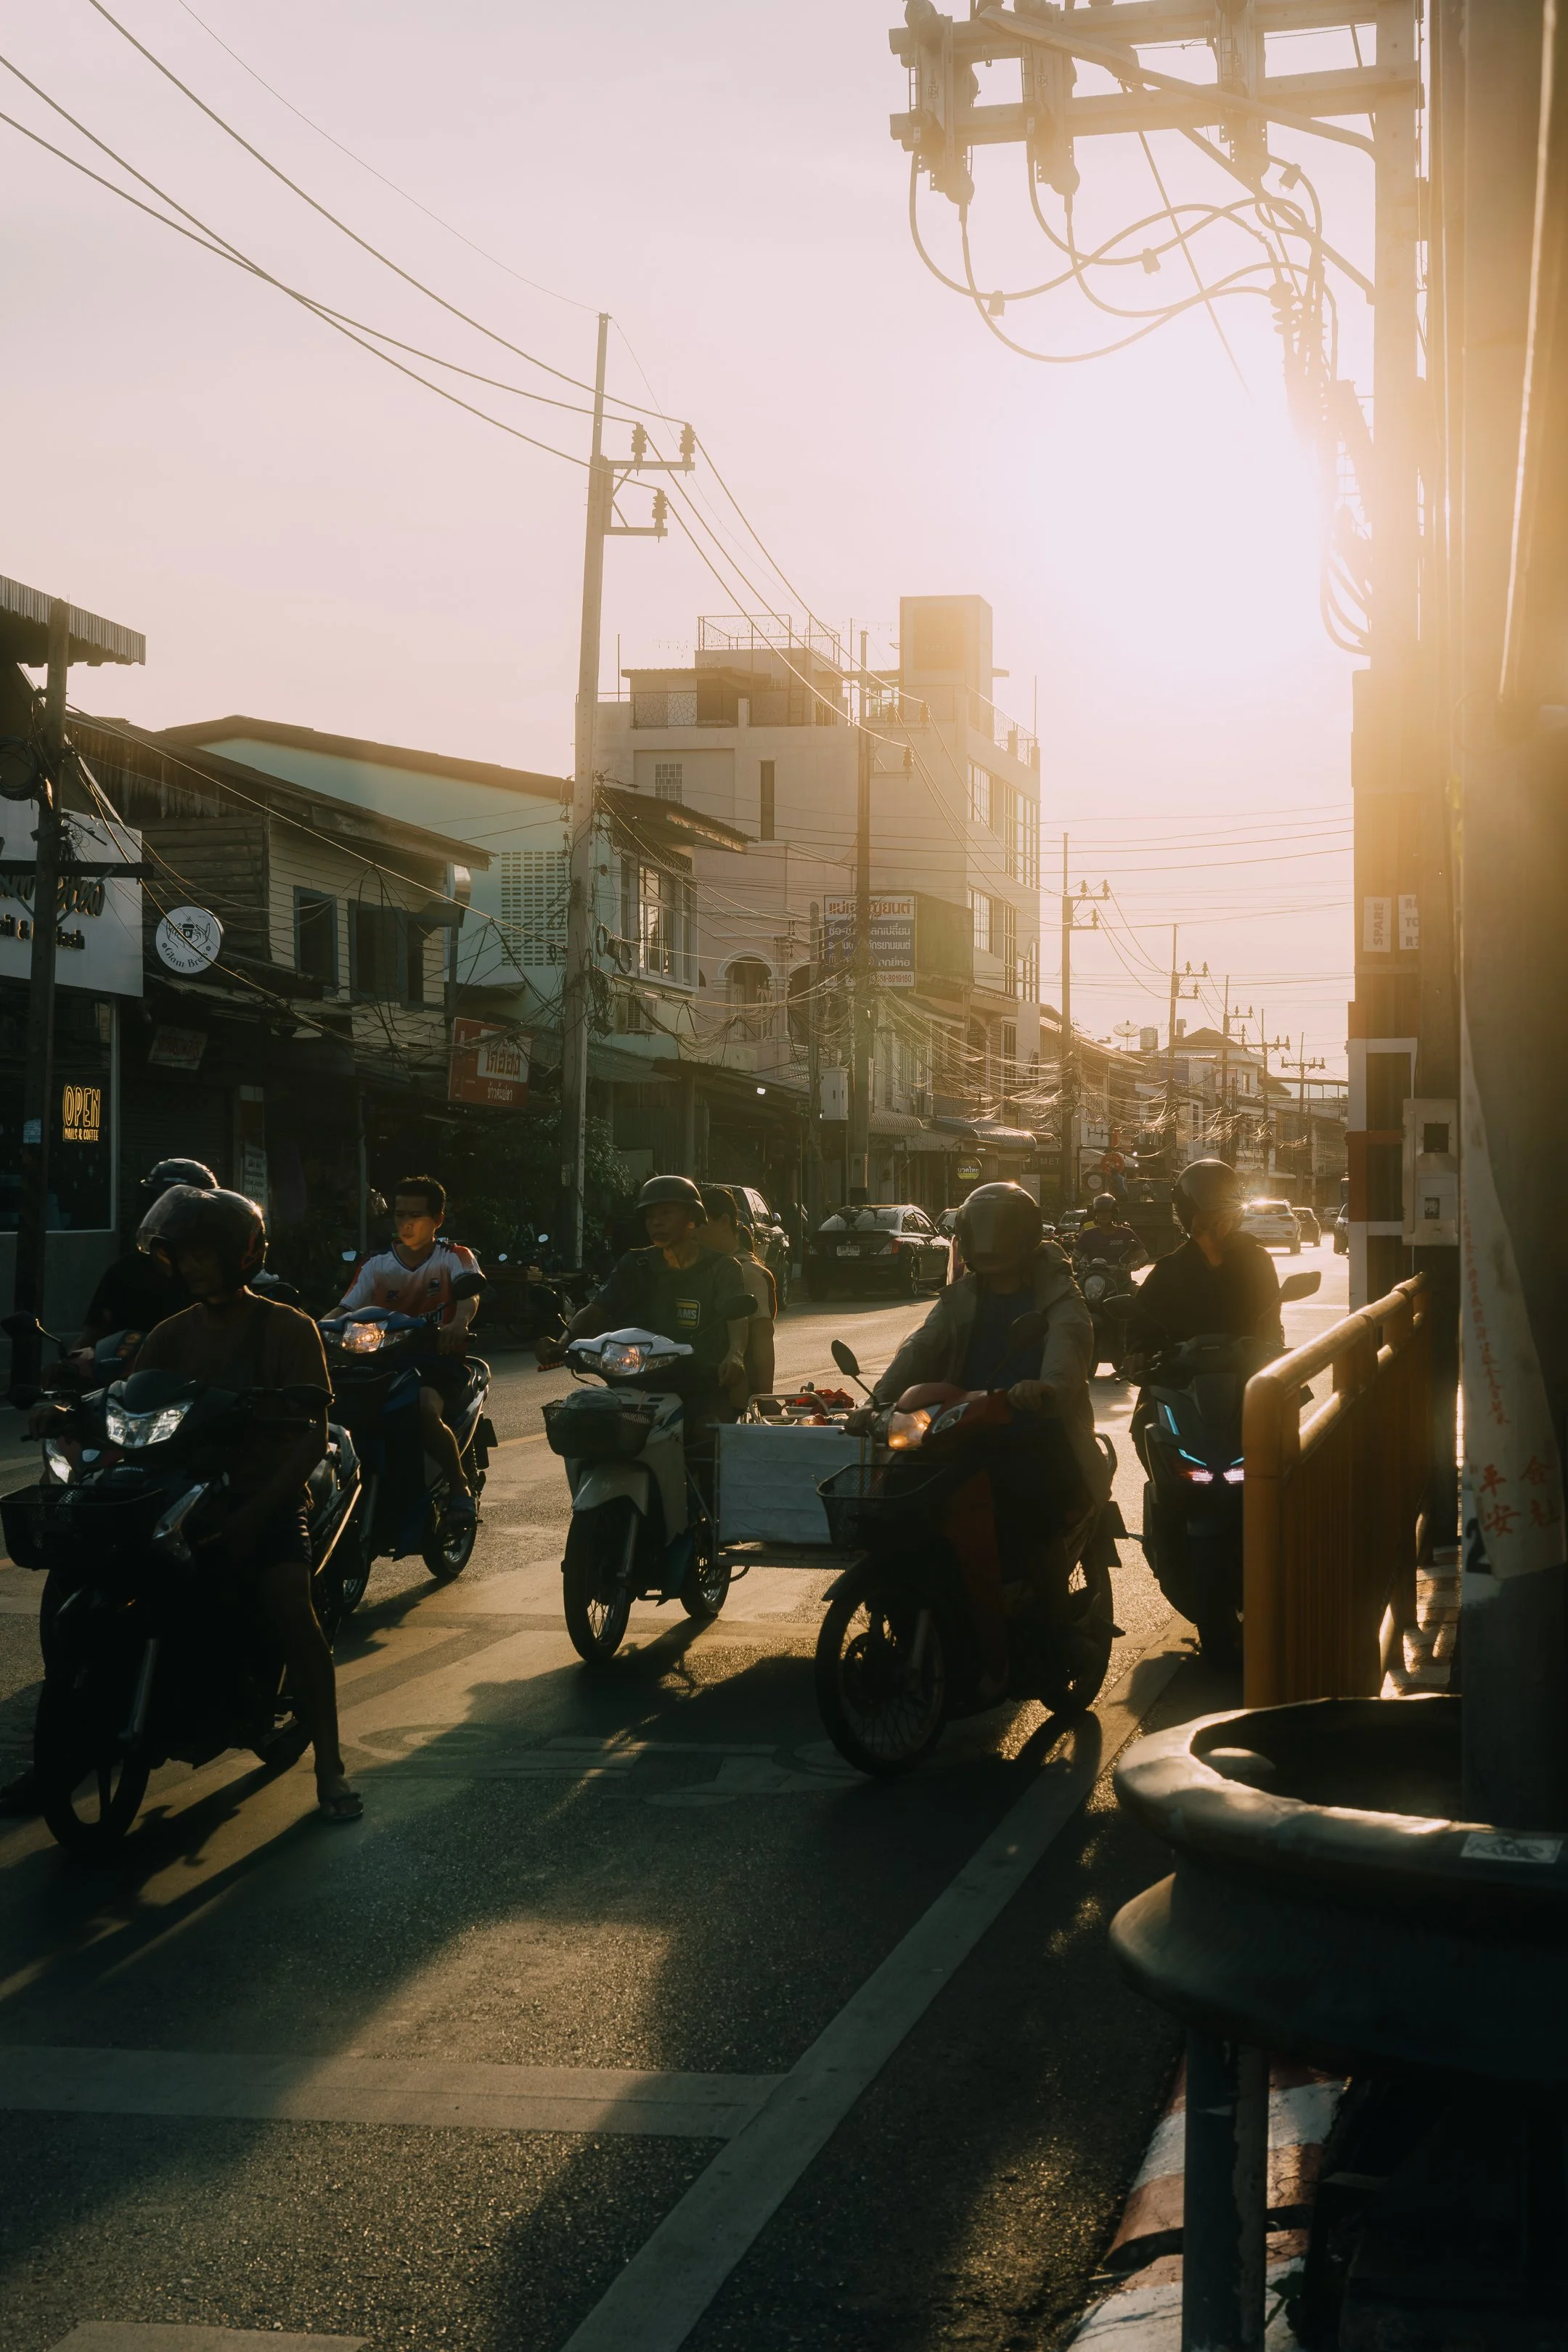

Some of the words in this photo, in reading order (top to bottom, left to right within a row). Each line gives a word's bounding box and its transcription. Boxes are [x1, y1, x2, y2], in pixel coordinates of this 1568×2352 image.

[1373, 903, 1384, 946] SPARE
[868, 940, 911, 950] ักรยานยนต์
[164, 947, 184, 968] Glam
[65, 1086, 100, 1128] OPEN
[65, 1127, 78, 1140] NAILS
[78, 1128, 83, 1140] &
[83, 1129, 99, 1141] COFFEE
